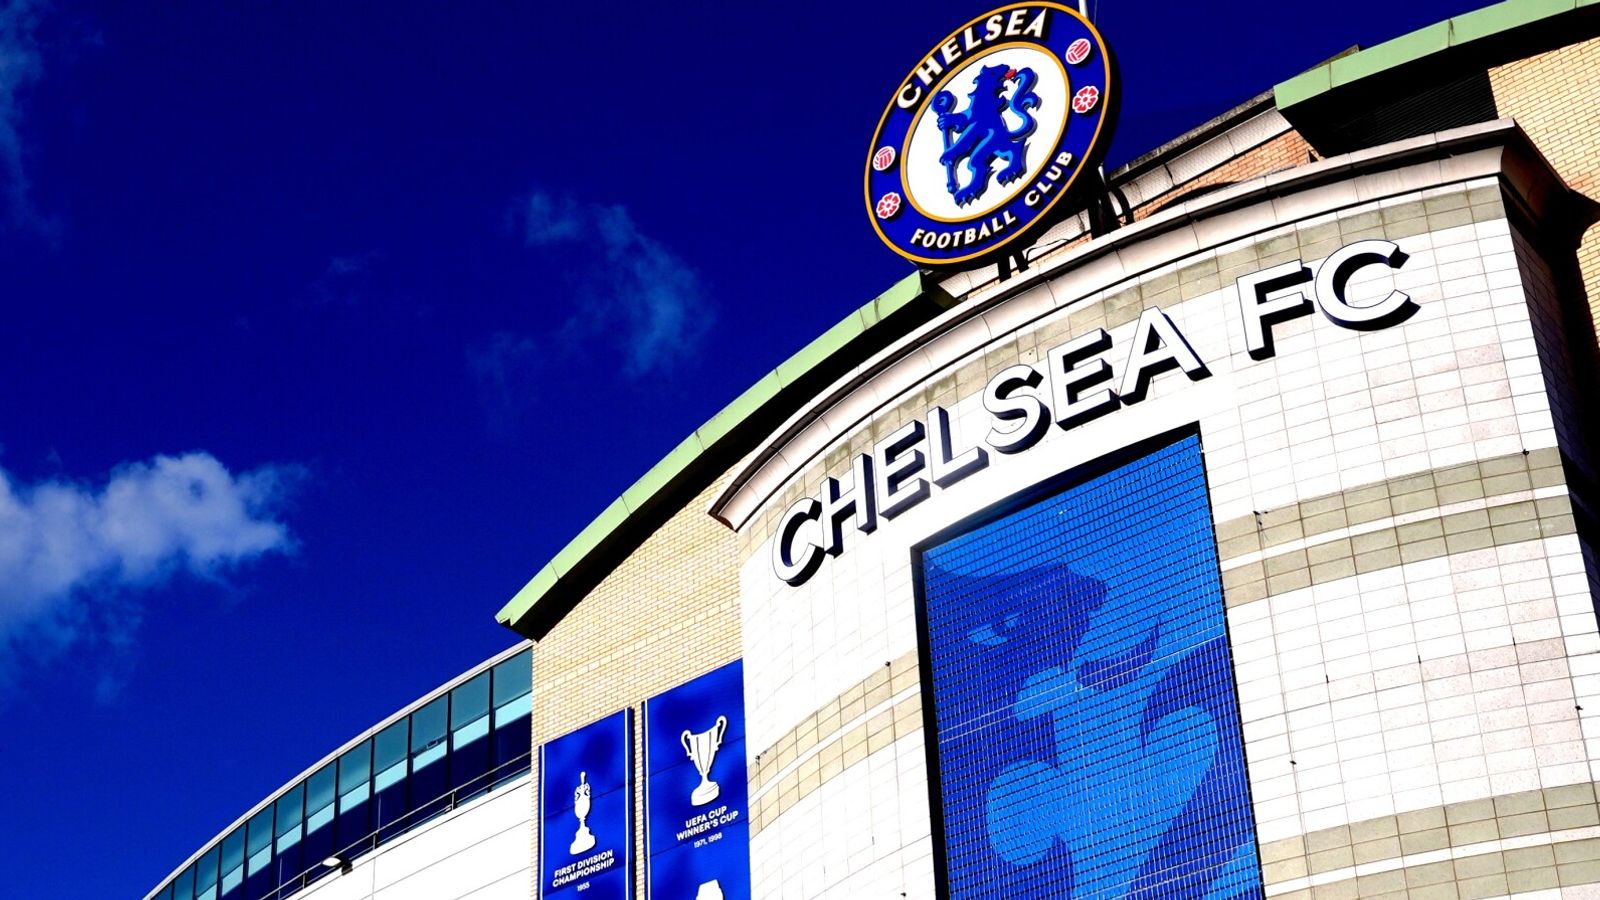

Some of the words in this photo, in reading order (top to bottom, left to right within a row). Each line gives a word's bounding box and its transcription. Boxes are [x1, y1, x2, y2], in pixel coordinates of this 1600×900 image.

[897, 8, 1048, 109] CHELSEA
[910, 210, 1016, 249] FOOTBALL
[1024, 151, 1073, 207] CLUB
[772, 305, 1212, 587] CHELSEA
[1236, 239, 1421, 361] FC
[676, 818, 719, 841] WINNER'S
[720, 810, 739, 824] CUP
[685, 814, 707, 828] UEFA
[708, 805, 727, 819] CUP
[552, 858, 615, 887] CHAMPIONSHIP
[554, 863, 577, 878] FIRST
[578, 849, 613, 871] DIVISION
